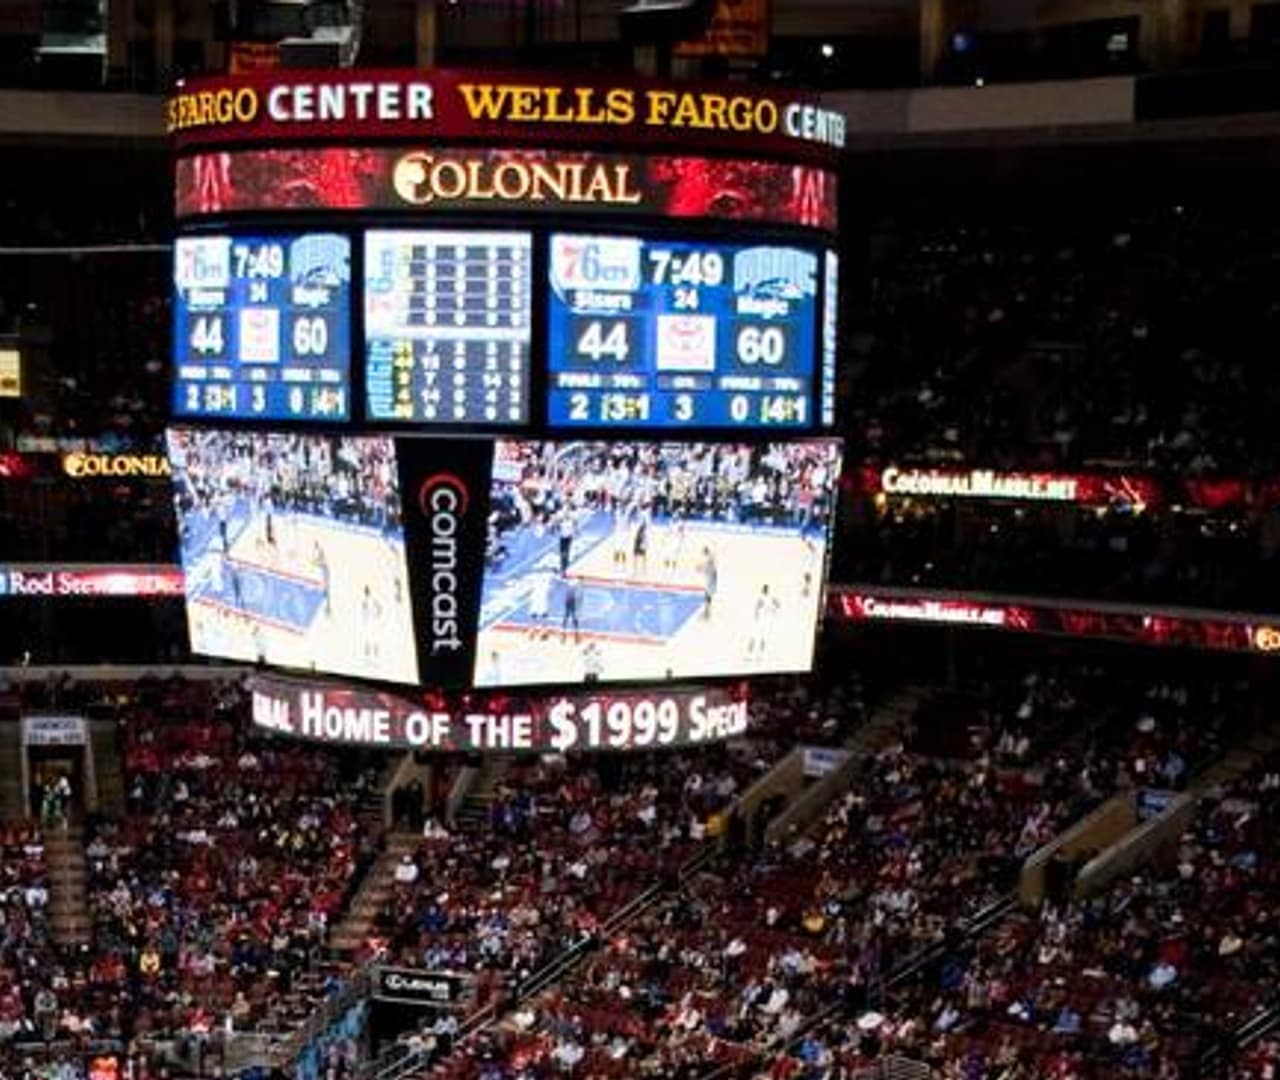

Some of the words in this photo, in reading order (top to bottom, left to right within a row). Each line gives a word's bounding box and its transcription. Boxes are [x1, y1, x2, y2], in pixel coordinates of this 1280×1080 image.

[267, 82, 434, 121] CENTER
[457, 84, 635, 124] WELLS
[645, 90, 779, 133] FARGO
[392, 151, 641, 205] COLONIAL
[234, 245, 284, 278] 7:49
[649, 251, 724, 286] 7:49
[674, 289, 699, 309] 24
[191, 317, 224, 354] 44
[293, 317, 328, 355] 60
[577, 322, 629, 361] 44
[736, 327, 784, 364] 60
[570, 394, 589, 421] 2
[675, 395, 693, 421] 3
[731, 396, 748, 421] 0
[63, 453, 171, 478] COLONIA
[10, 570, 54, 595] Rod
[300, 691, 390, 743] HOME
[405, 713, 450, 745] OF
[465, 714, 532, 748] THE
[549, 697, 679, 752] $1999
